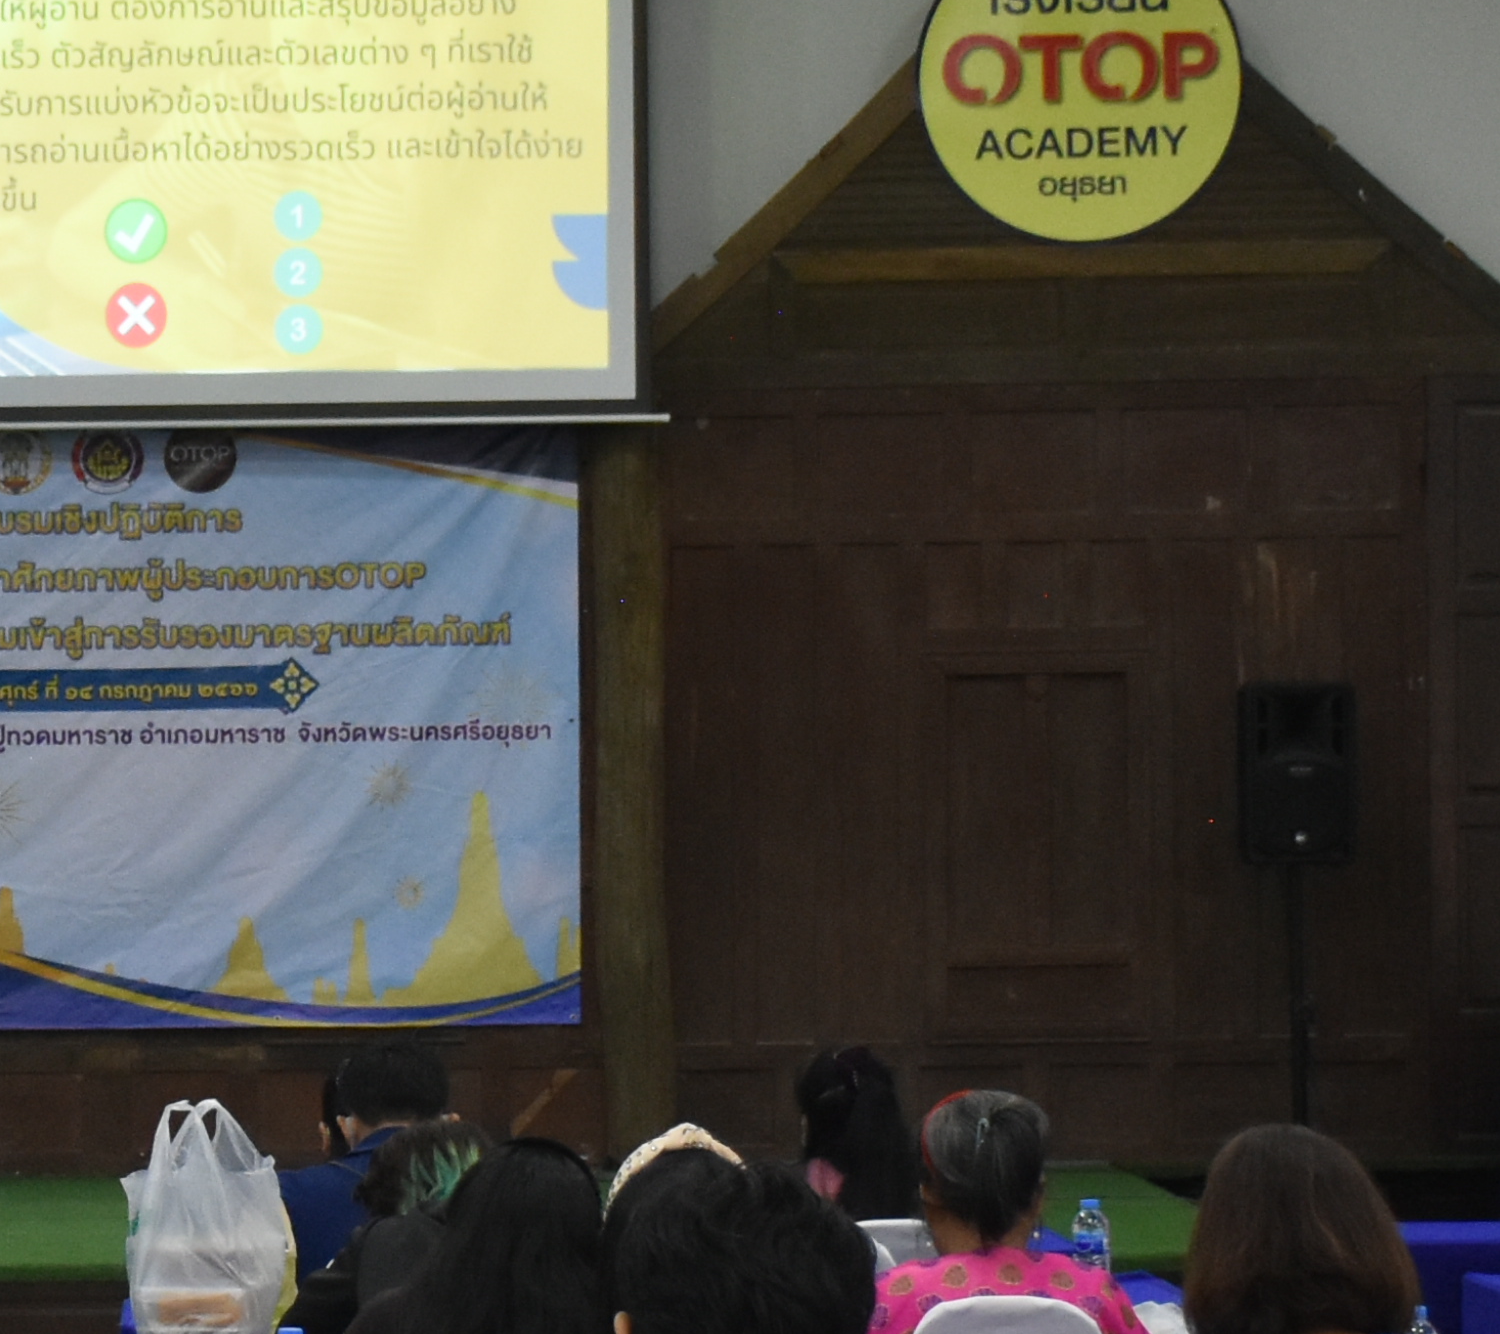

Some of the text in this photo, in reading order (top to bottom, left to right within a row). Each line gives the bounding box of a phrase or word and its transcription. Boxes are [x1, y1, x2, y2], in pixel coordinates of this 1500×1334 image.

[51, 35, 409, 72] ตัวสัญลักษณ์และตัวเลขต่าง
[420, 42, 438, 70] ๆ
[448, 29, 534, 65] ที่เราใช้
[942, 30, 1221, 107] OTOP
[387, 128, 584, 161] และเข้าใจได้ง่าย
[974, 125, 1188, 161] ACADEMY
[1038, 174, 1129, 203] อยุธยา
[289, 203, 304, 229] 1
[288, 259, 308, 286] 2
[289, 316, 308, 343] 3
[170, 446, 230, 462] OTOP
[44, 675, 61, 701] ที่
[101, 681, 193, 703] กรกฎาคม
[140, 721, 286, 746] อำเภอมหาราช
[298, 717, 552, 748] จังหวัดพระนครศรีอยุธยา
